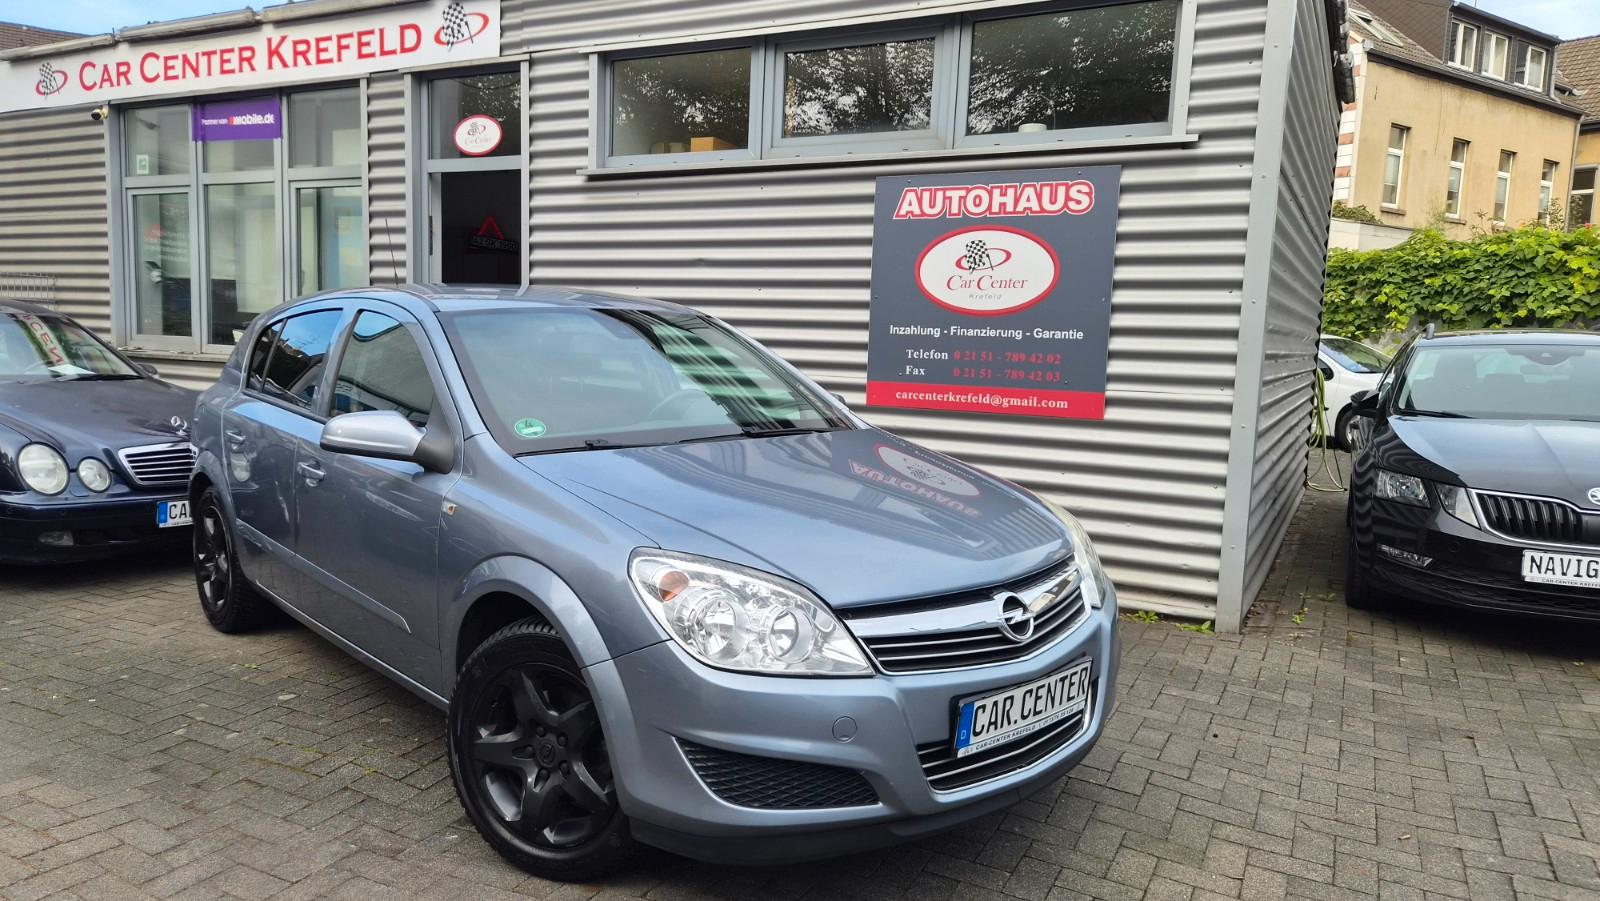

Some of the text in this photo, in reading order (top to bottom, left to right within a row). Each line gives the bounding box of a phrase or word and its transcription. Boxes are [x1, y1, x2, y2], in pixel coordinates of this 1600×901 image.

[79, 23, 422, 92] CAR CENTER KREFELD
[893, 180, 1094, 220] AUTOHAUS
[946, 274, 1028, 291] Car Center
[889, 324, 941, 338] Inzahlung
[950, 325, 1023, 340] Finanzierung
[1033, 327, 1084, 340] Garantie
[906, 349, 949, 360] Telefon
[954, 351, 961, 360] 0
[963, 352, 976, 361] 21
[980, 352, 993, 361] 51
[1005, 352, 1025, 363] 789
[1028, 354, 1044, 364] 42
[1046, 354, 1062, 365] 02
[905, 365, 926, 376] Fax
[953, 368, 961, 377] 0
[963, 368, 976, 378] 21
[979, 369, 992, 378] 51
[1004, 369, 1025, 380] 789
[1028, 370, 1043, 381] 42
[1046, 371, 1061, 382] 03
[896, 390, 1068, 409] carcenterkrefeld@gmail.com
[1529, 554, 1599, 579] NAVIG
[960, 729, 967, 740] D
[973, 667, 1088, 737] CAR.CENTER
